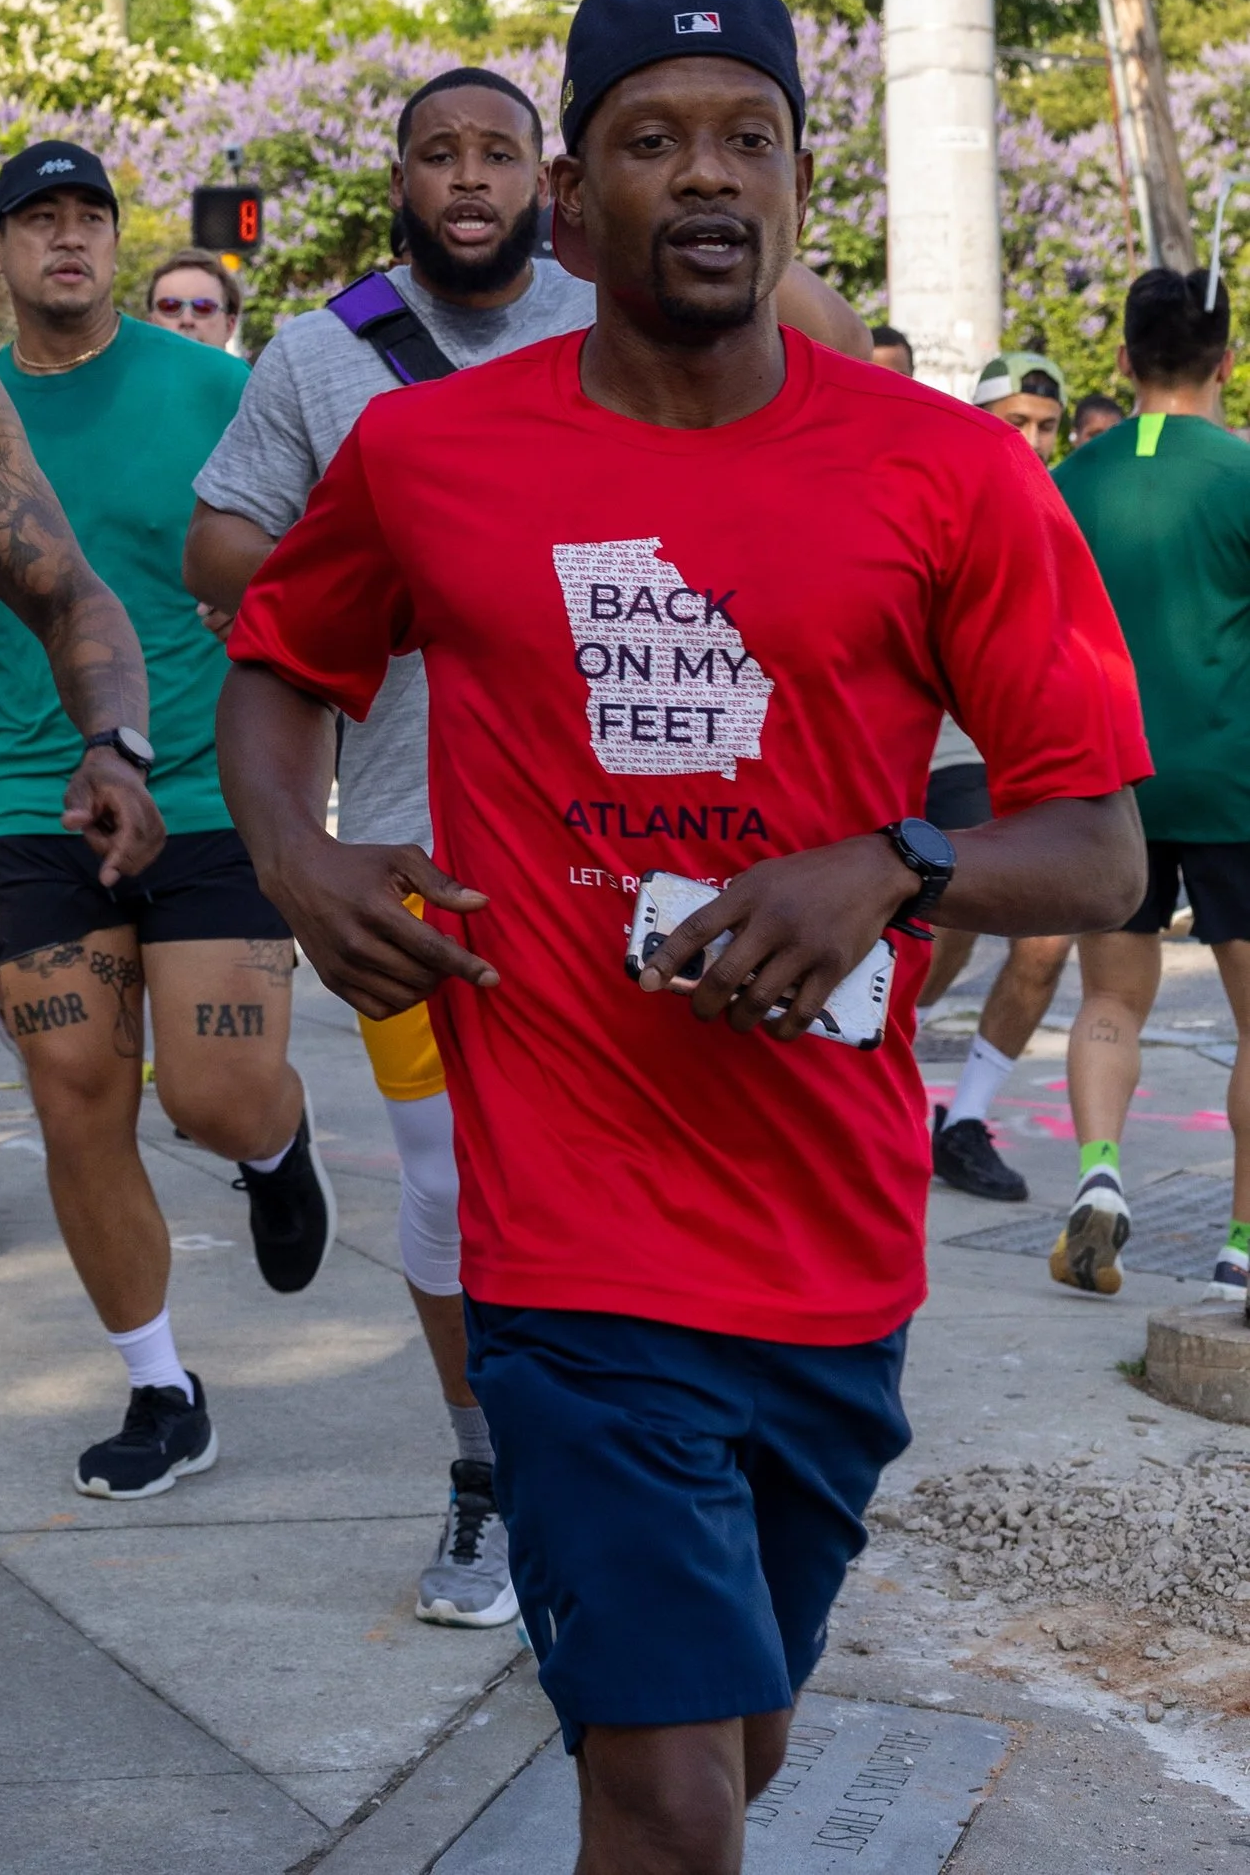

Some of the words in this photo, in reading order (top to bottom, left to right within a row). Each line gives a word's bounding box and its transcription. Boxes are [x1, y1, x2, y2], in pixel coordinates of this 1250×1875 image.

[590, 583, 737, 626] BACK
[575, 642, 651, 681] ON
[675, 647, 755, 685] MY
[600, 703, 725, 743] FEET
[563, 800, 769, 842] ATLANTA
[569, 866, 619, 889] LET'S
[13, 992, 88, 1036] AMOR
[195, 1003, 264, 1037] FATI
[843, 1728, 933, 1806] ATLANTA'S
[811, 1807, 885, 1856] FIRST
